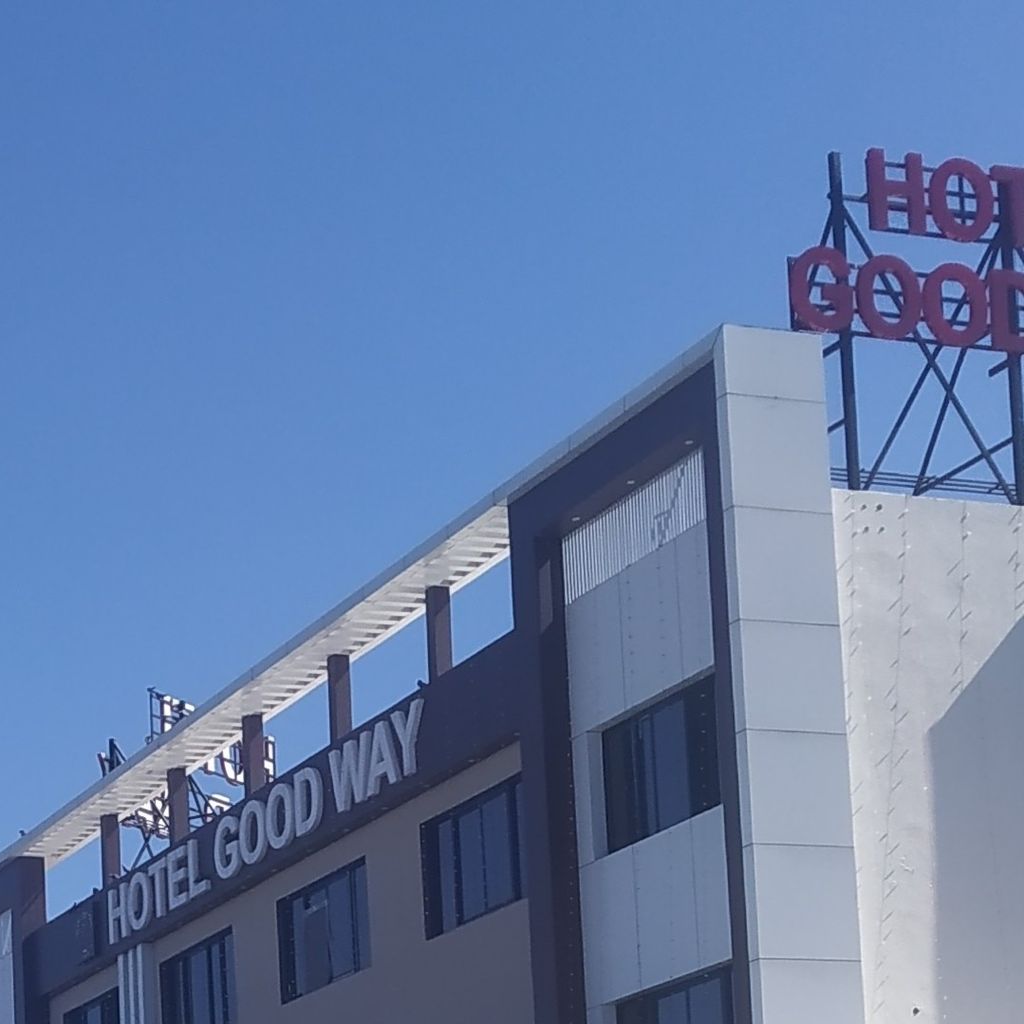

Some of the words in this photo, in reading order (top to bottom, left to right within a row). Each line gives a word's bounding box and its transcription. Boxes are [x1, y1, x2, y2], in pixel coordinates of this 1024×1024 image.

[107, 838, 212, 945] HOTEL
[214, 767, 324, 880] GOOD
[328, 698, 424, 814] WAY
